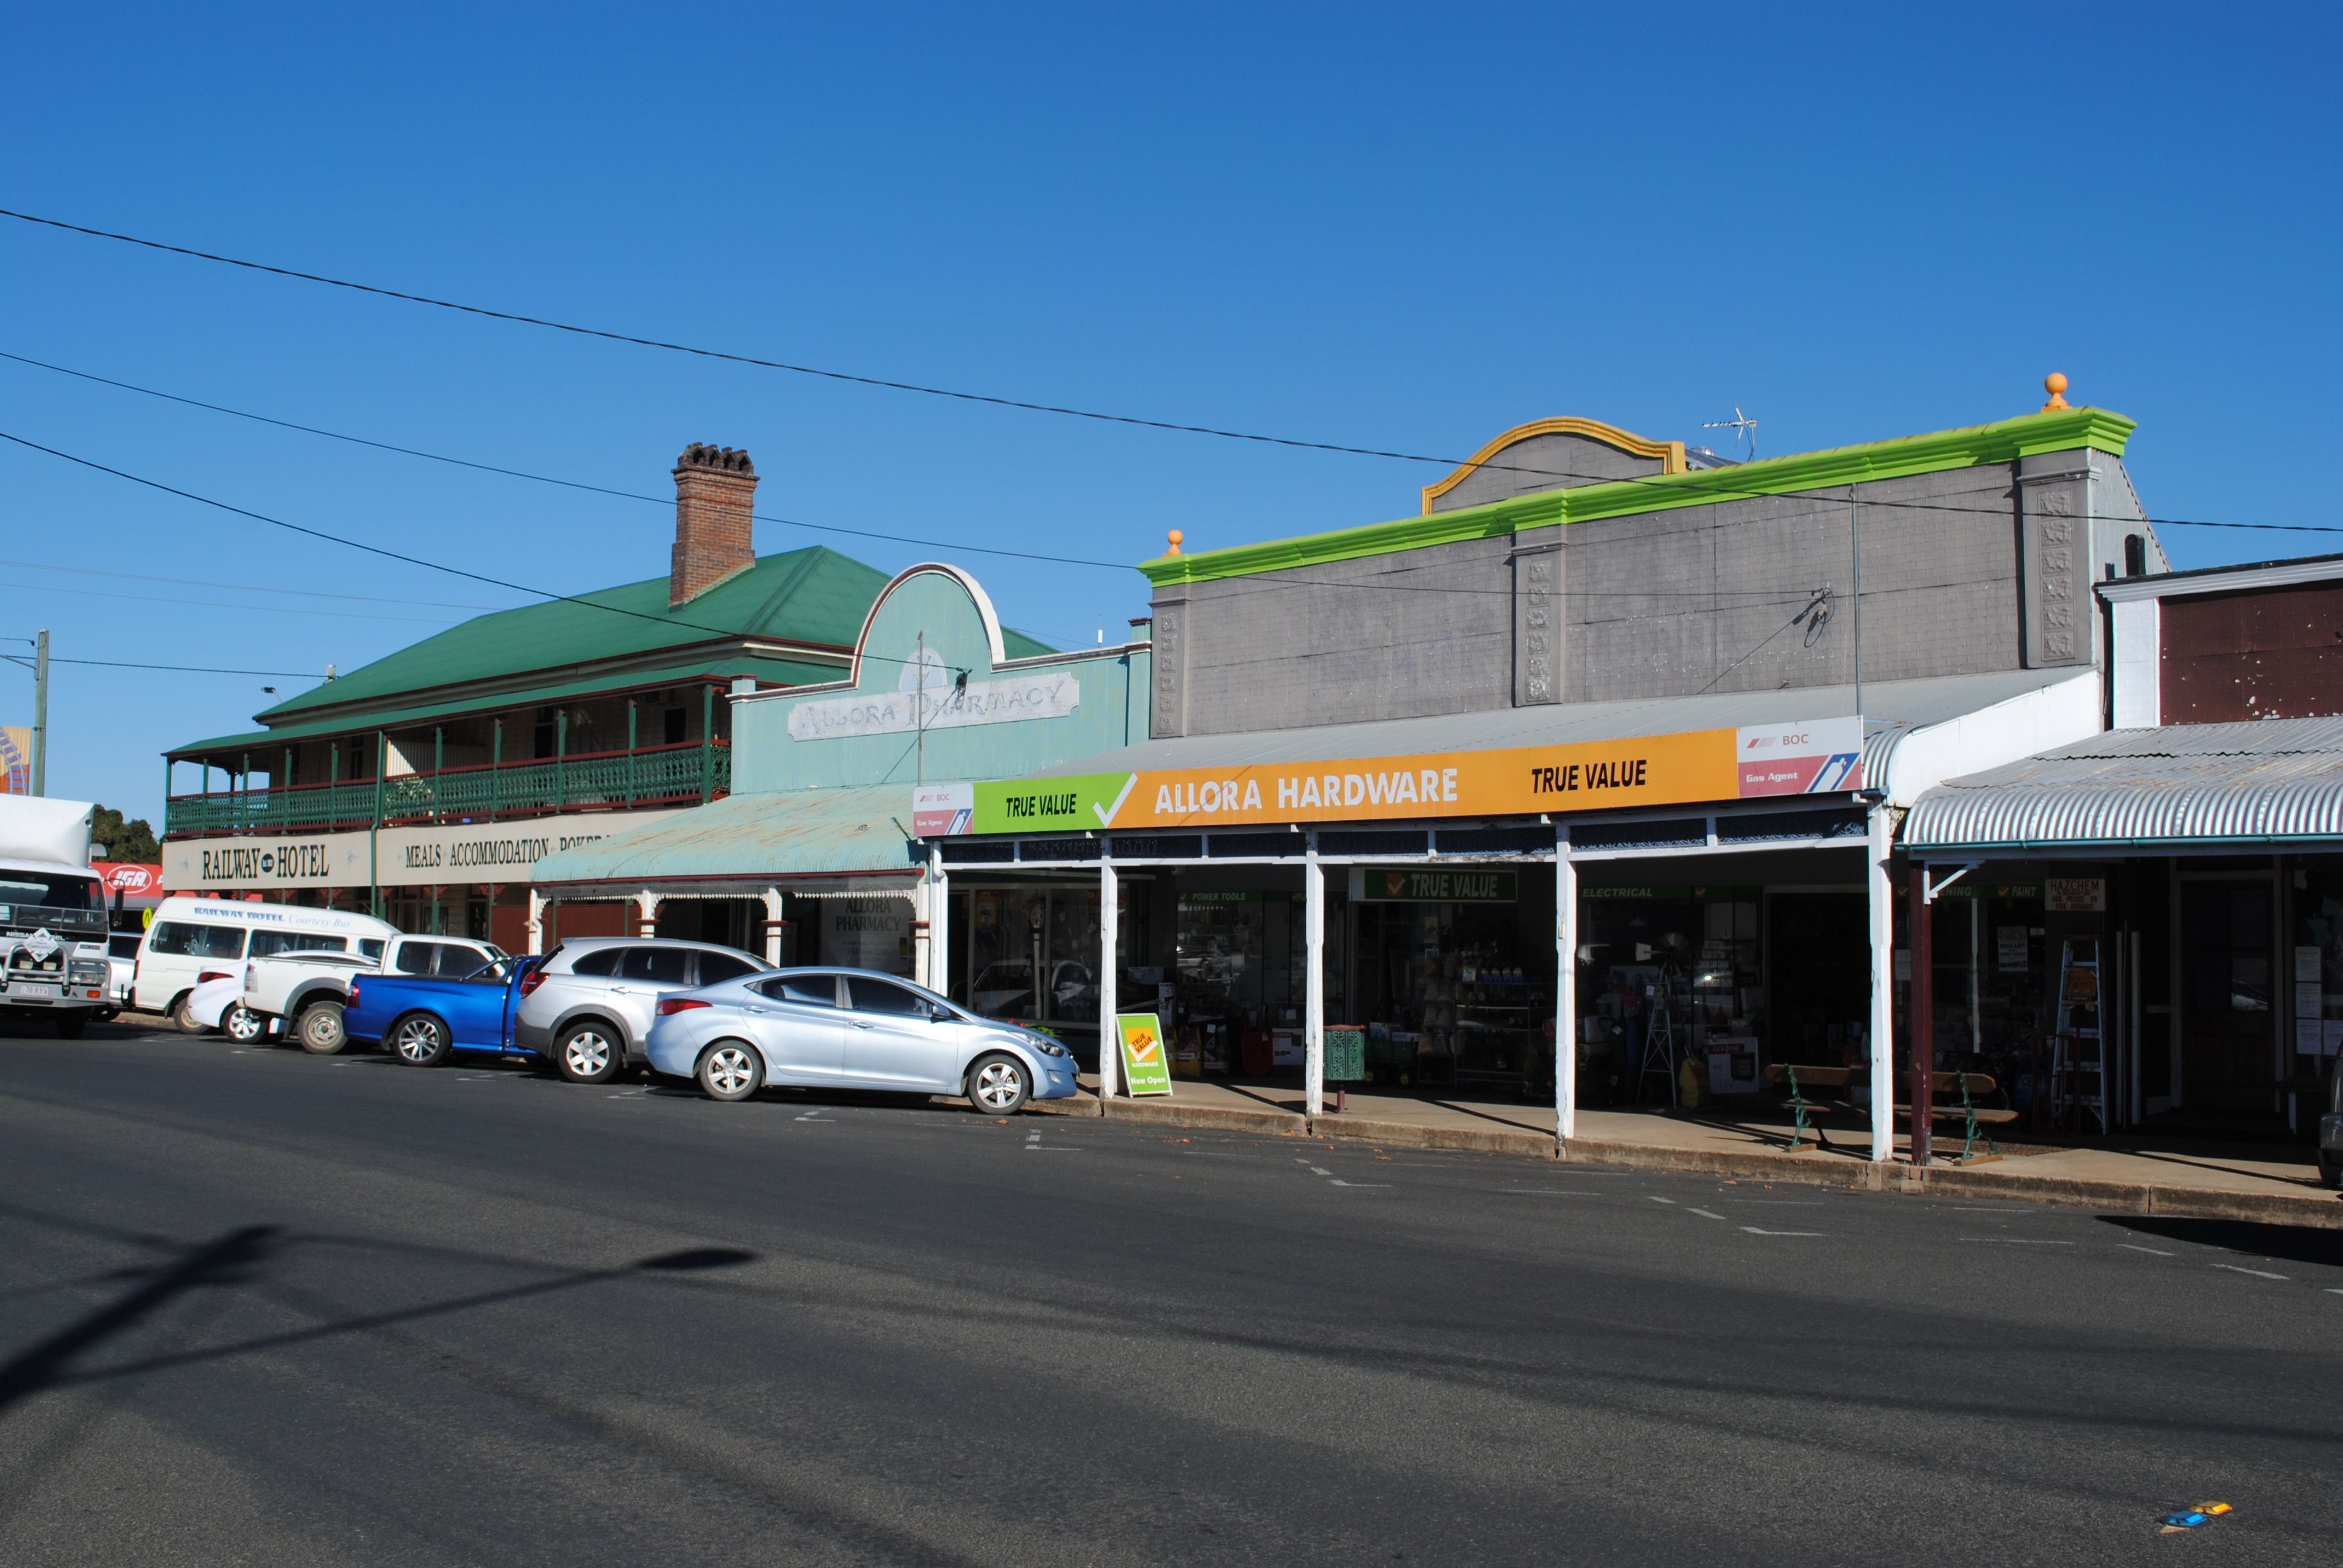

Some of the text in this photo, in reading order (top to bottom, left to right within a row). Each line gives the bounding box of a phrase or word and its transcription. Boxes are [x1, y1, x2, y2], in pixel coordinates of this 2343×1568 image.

[802, 680, 1064, 734] ALLORA PHARMACY
[1783, 734, 1809, 746] BOC
[1531, 759, 1647, 794] TRUE VALUE
[1746, 771, 1799, 783] Gas Agent
[937, 794, 949, 802] BOC
[1155, 768, 1458, 814] ALLORA HARDWARE
[1006, 794, 1076, 818] TRUE VALUE
[405, 844, 442, 868] MEALS
[450, 838, 549, 866] ACCOMMODATION
[203, 844, 330, 880] RAILWAY HOTEL
[113, 871, 147, 887] IGA
[1411, 874, 1498, 898] TRUE VALUE
[2050, 880, 2099, 891] HAZCHEM
[1192, 892, 1246, 901] POWER TOOLS
[1582, 887, 1654, 898] ELECTRICAL
[2011, 886, 2037, 897] PAINT
[845, 899, 892, 913] ALLORA
[194, 907, 351, 929] RAILWAY HOTEL Courtesy Bus
[836, 916, 902, 932] PHARMACY
[1132, 1033, 1146, 1047] TRUE
[1135, 1036, 1153, 1053] VALUE
[1147, 1076, 1165, 1085] Open
